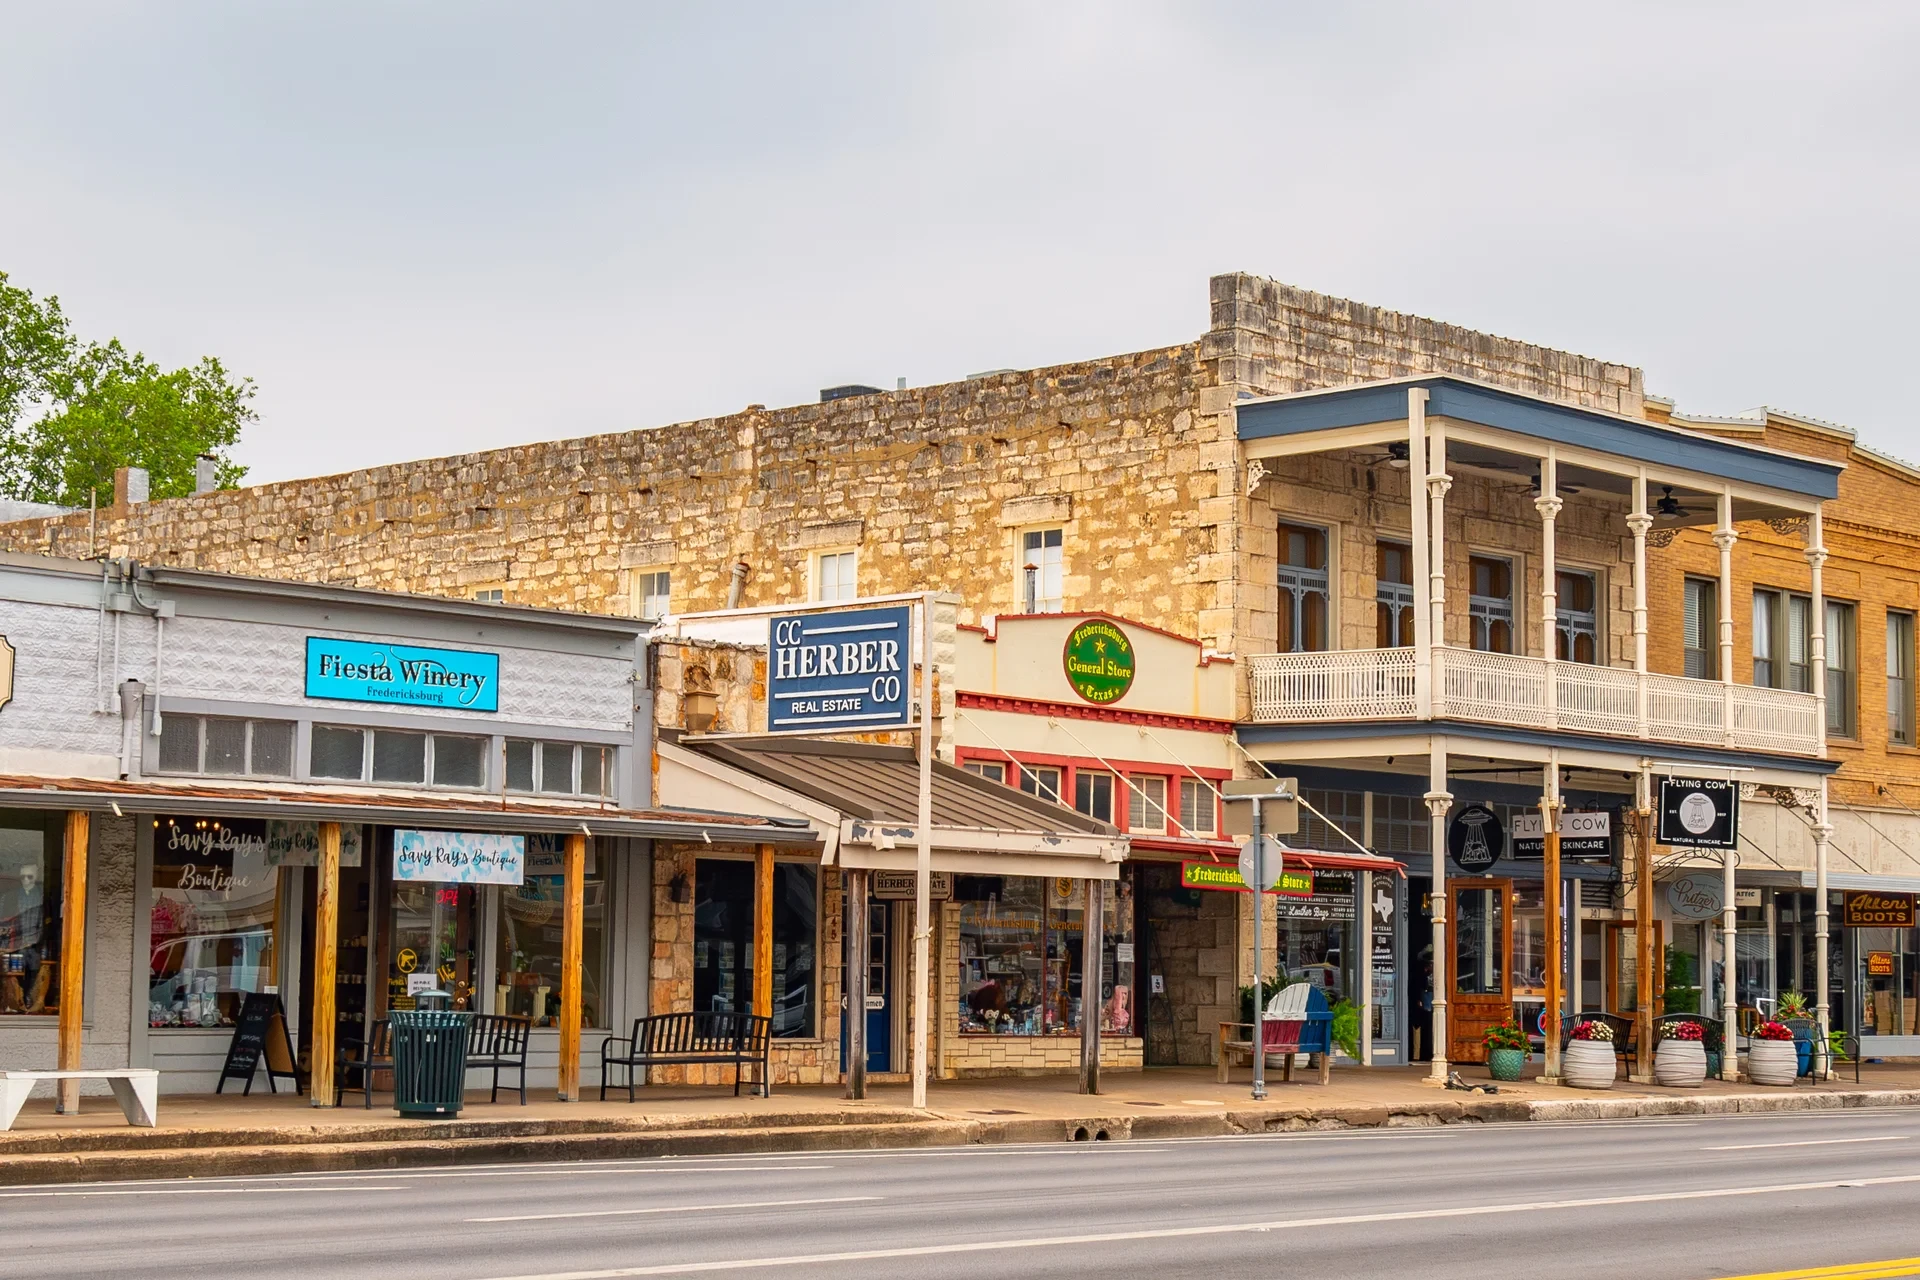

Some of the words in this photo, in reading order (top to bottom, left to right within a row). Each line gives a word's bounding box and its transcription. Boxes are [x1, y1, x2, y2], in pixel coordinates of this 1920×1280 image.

[776, 620, 802, 646] CC
[1074, 624, 1128, 652] Fredericksburg
[775, 639, 901, 679] HERBER
[1068, 656, 1105, 675] General
[1107, 660, 1131, 678] Store
[319, 652, 395, 684] Fiesta
[396, 655, 487, 707] Winery
[871, 675, 901, 702] CO
[367, 685, 444, 704] Fredericksburg
[1086, 684, 1114, 700] Texas
[791, 701, 820, 714] REAL
[822, 698, 861, 712] ESTATE
[1670, 779, 1702, 788] FLYING
[1705, 781, 1727, 790] COW
[1571, 818, 1607, 831] COW
[168, 825, 215, 856] Savy
[217, 827, 265, 857] Ray's
[268, 833, 294, 850] Savy
[1562, 841, 1604, 850] SKINCARE
[1697, 838, 1721, 846] SKINCARE
[399, 845, 432, 867] Savy
[436, 846, 469, 868] Ray's
[471, 848, 518, 871] Boutique
[177, 863, 251, 900] Boutique
[877, 879, 915, 889] HERBER
[1193, 866, 1245, 885] Fredericksbu
[1282, 875, 1303, 889] Store
[1673, 878, 1722, 913] Pritzer
[1850, 894, 1909, 911] Allens
[1289, 905, 1312, 916] Leather
[1852, 912, 1907, 922] BOOTS
[830, 902, 838, 940] 145
[1870, 954, 1891, 965] Allens
[1870, 965, 1890, 973] BOOTS
